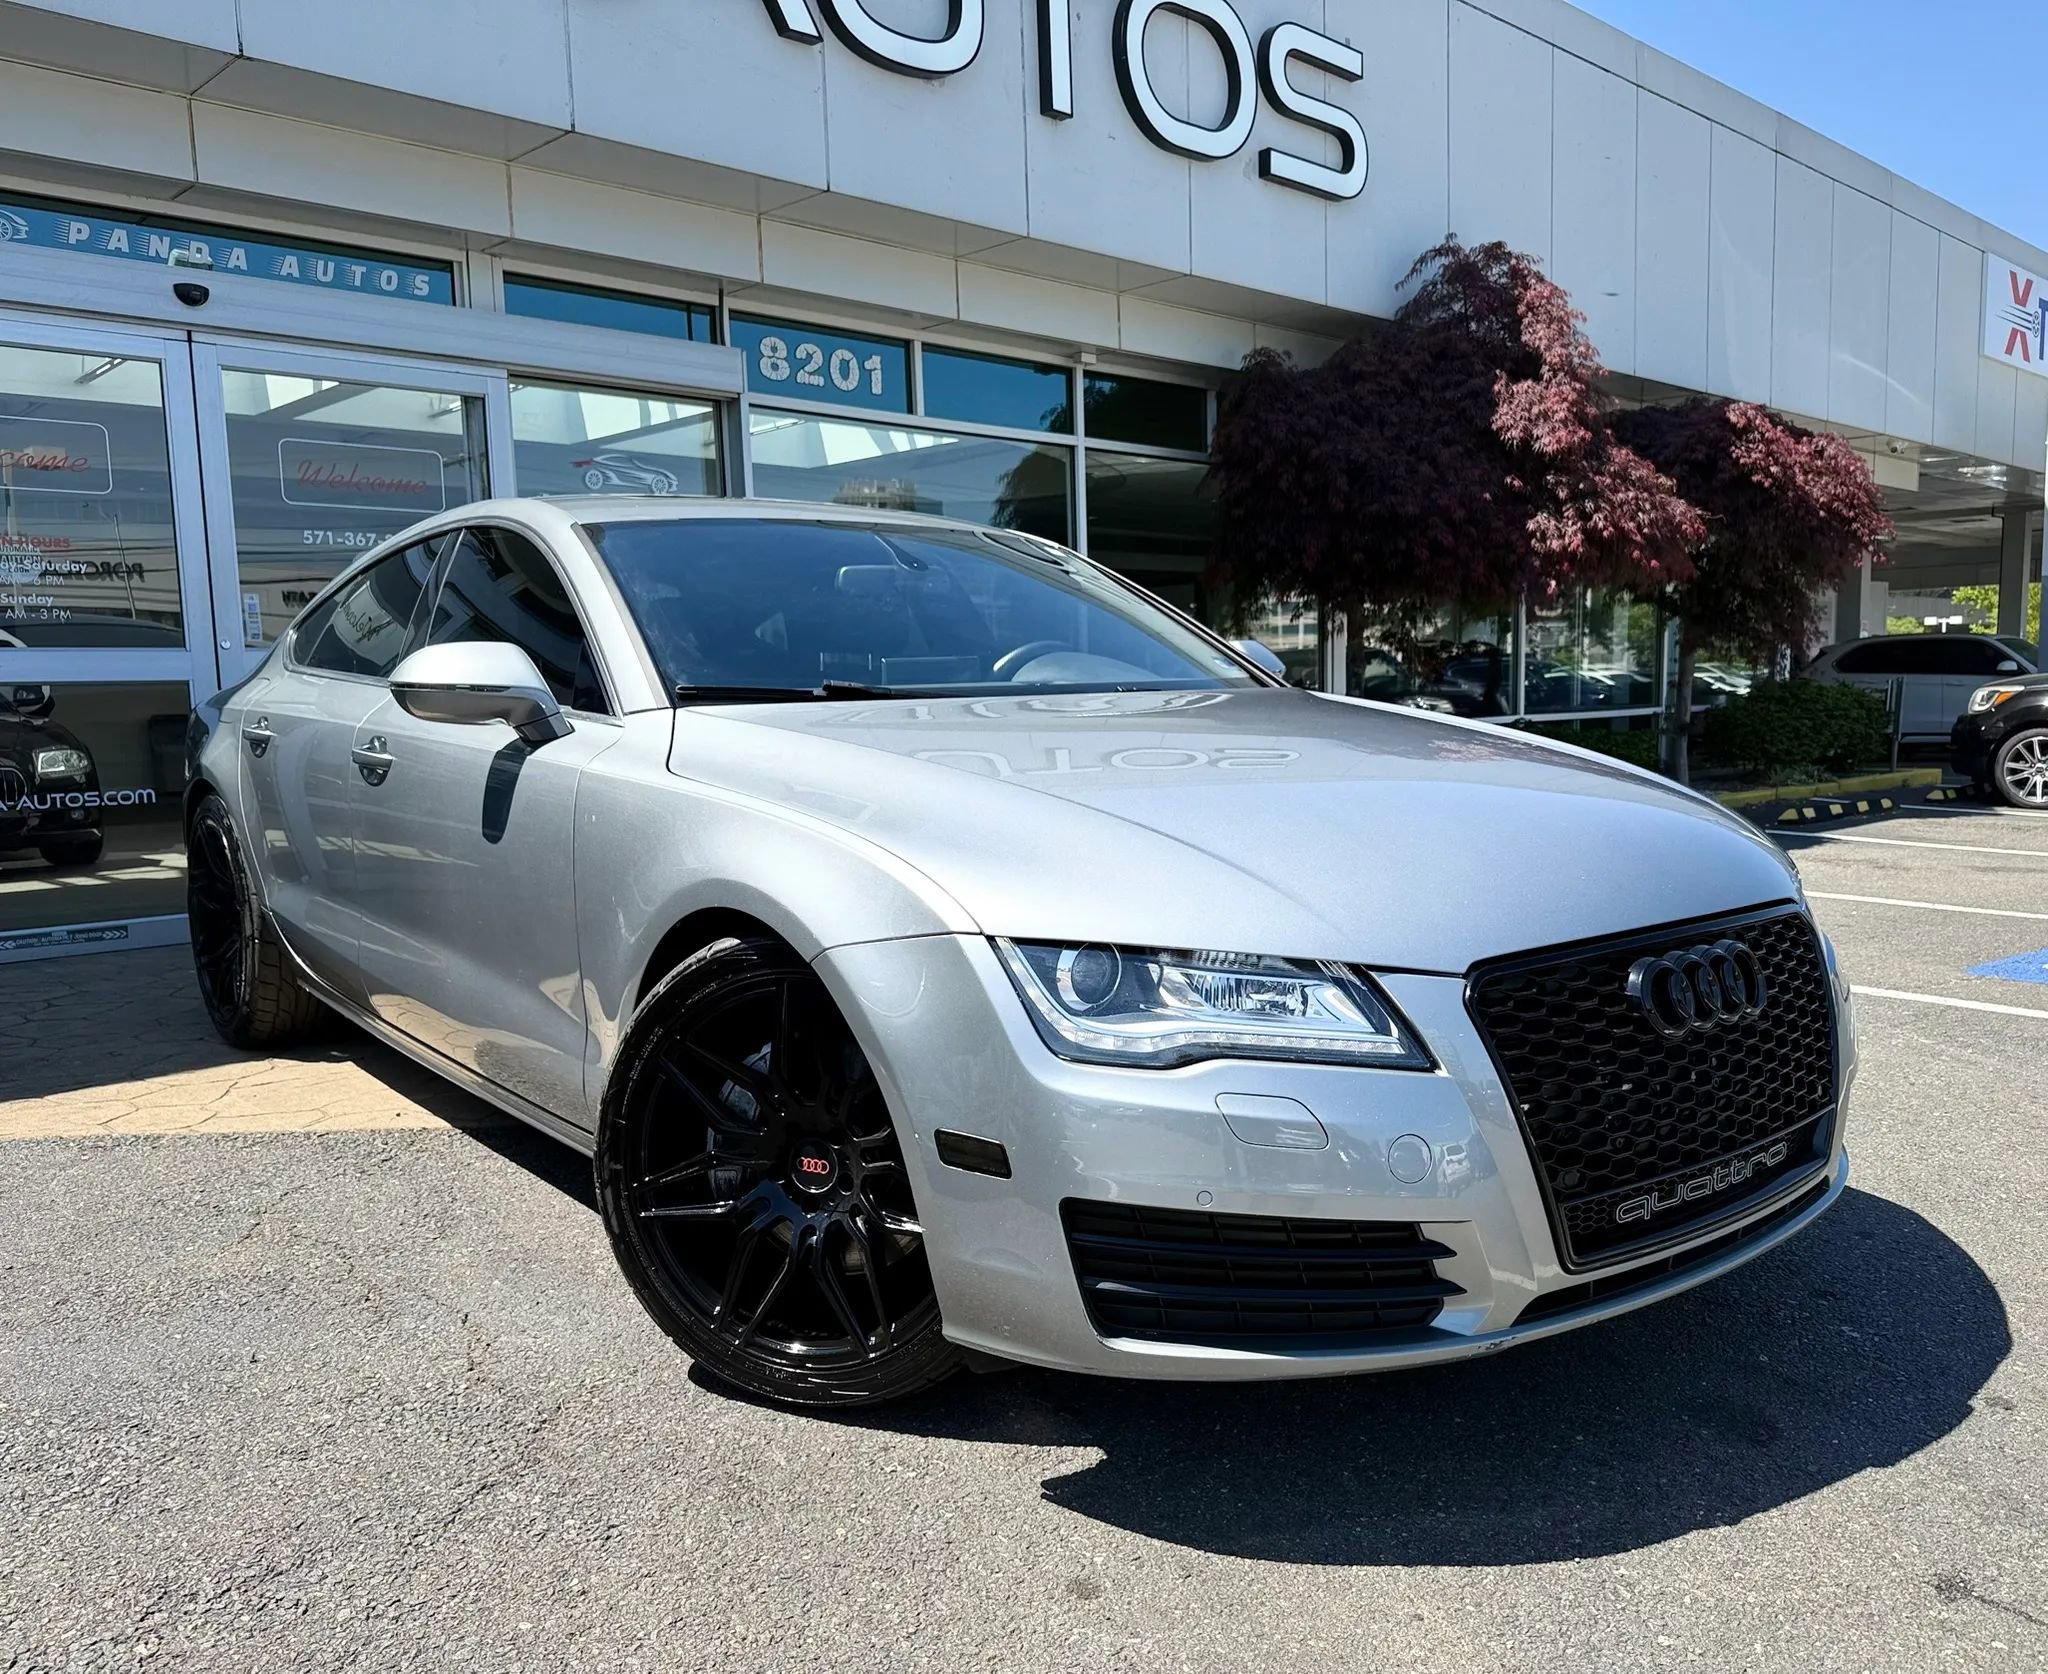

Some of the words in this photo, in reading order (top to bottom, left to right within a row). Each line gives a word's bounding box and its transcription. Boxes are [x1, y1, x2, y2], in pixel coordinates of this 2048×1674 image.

[66, 220, 248, 272] PANDA
[279, 255, 431, 297] AUTOS
[760, 336, 883, 396] 8201
[297, 459, 432, 496] Welcome
[33, 576, 41, 586] 6
[45, 575, 65, 586] PM
[0, 593, 54, 607] Sunday
[5, 608, 28, 620] AM
[40, 608, 48, 620] 3
[52, 609, 72, 621] PM
[1616, 1141, 1788, 1224] quattro
